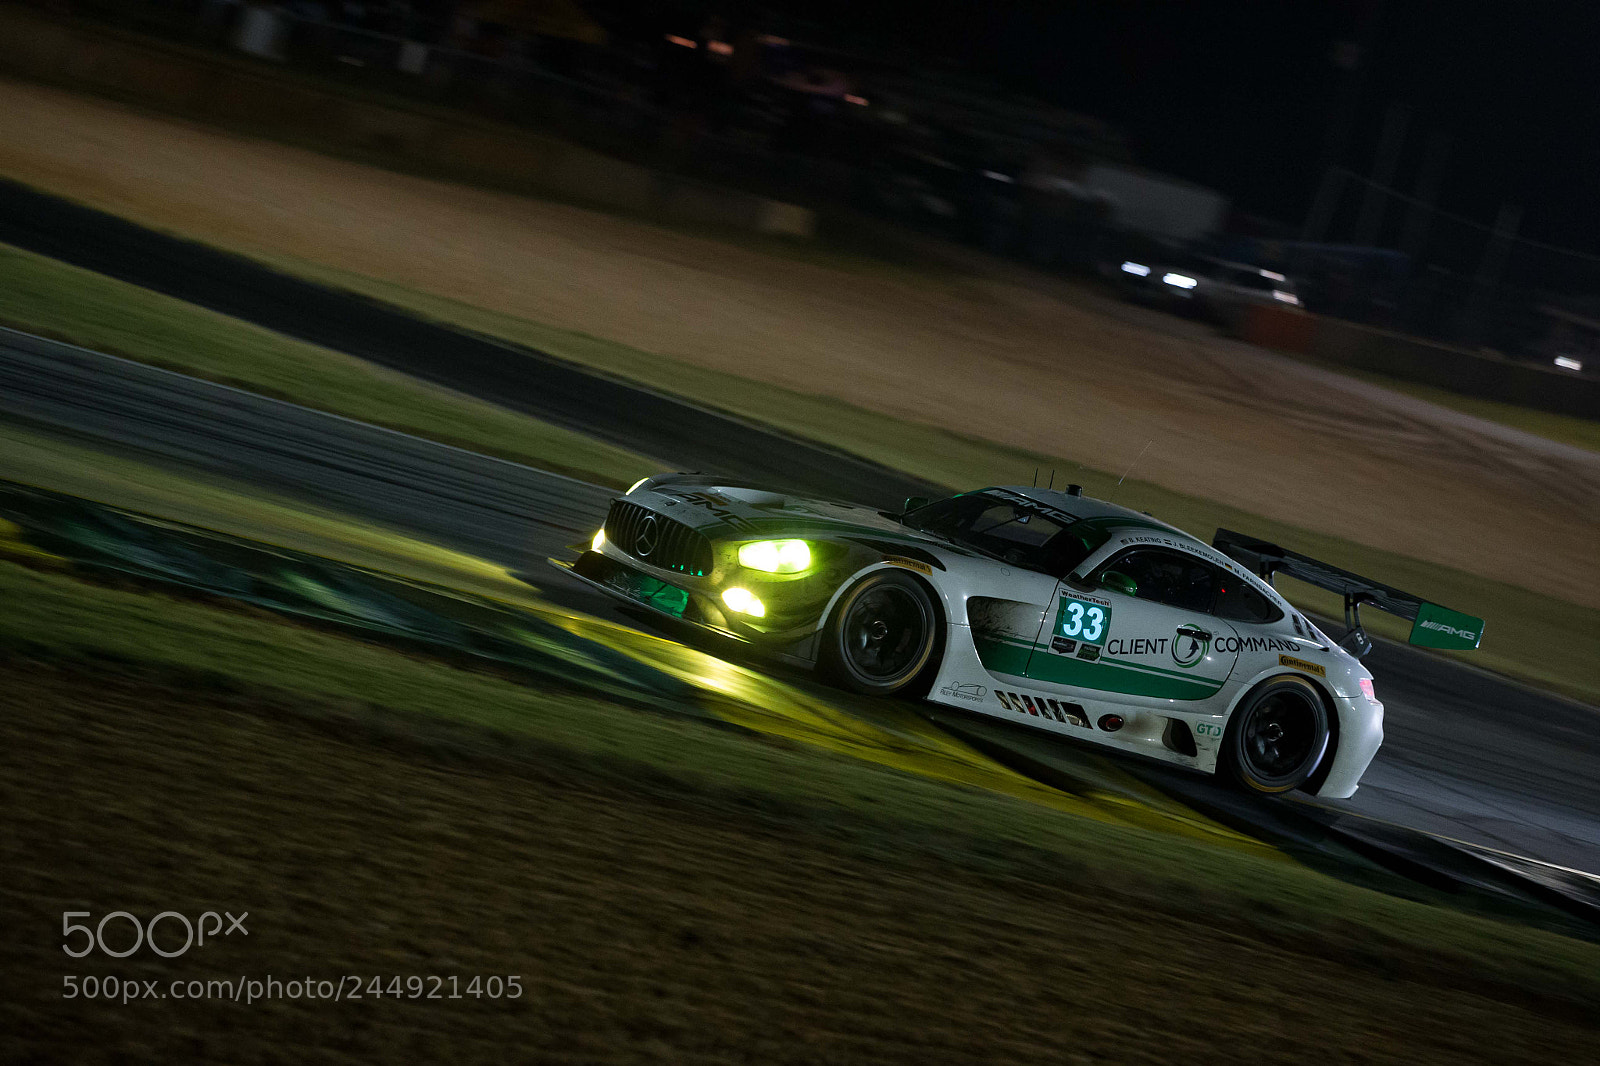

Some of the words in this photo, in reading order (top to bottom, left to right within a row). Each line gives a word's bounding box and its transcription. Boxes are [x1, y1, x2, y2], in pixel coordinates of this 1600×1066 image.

[1135, 536, 1162, 544] KEATING
[1061, 590, 1109, 606] WeatherTech
[1063, 602, 1104, 641] 33
[1436, 624, 1476, 640] AMG
[1107, 638, 1168, 655] CLIENT
[1214, 637, 1301, 653] COMMAND
[1281, 655, 1320, 673] Continental
[1196, 723, 1221, 737] GTD
